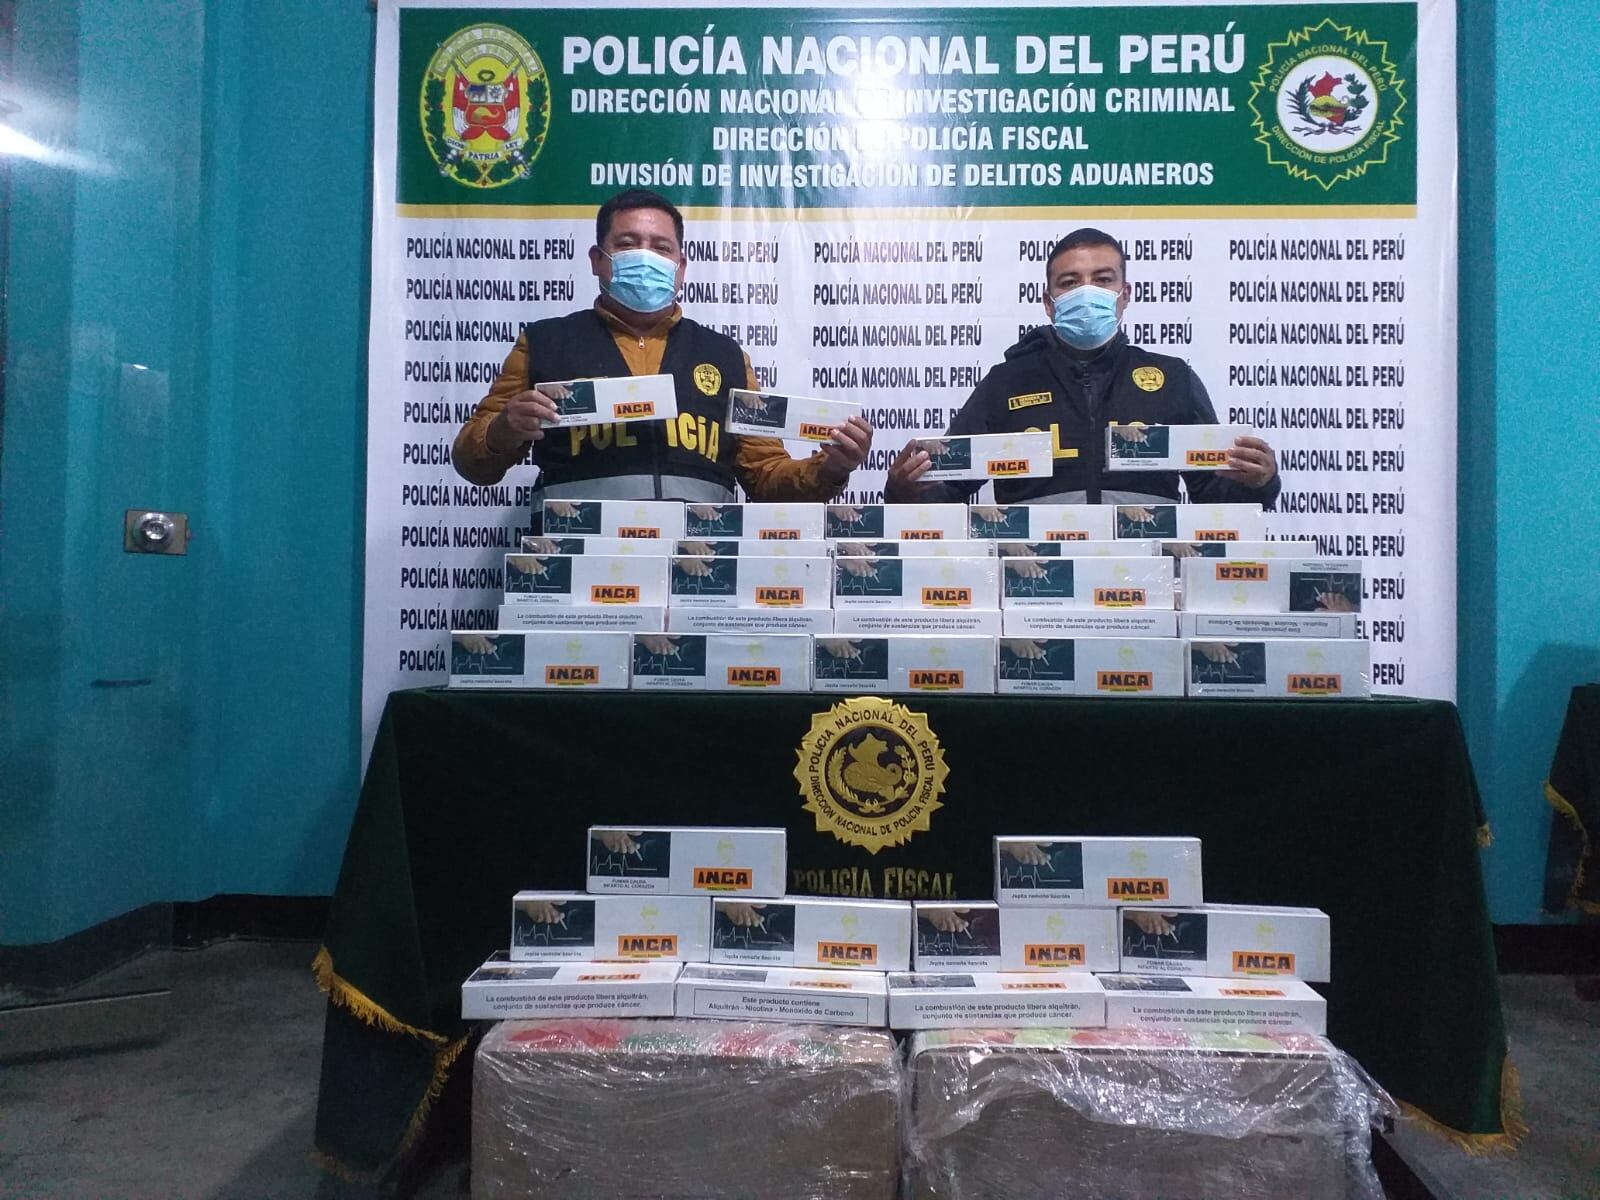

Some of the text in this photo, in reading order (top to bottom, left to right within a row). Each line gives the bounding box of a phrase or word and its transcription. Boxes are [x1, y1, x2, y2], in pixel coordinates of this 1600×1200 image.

[563, 24, 746, 75] POLICÍA
[763, 33, 998, 75] NACIONAL
[1016, 35, 1103, 74] DEL
[1120, 21, 1245, 74] PERÚ
[571, 85, 709, 113] DIRECCIÓN
[721, 88, 848, 114] NACIONAL
[899, 83, 1096, 114] INVESTIGACIÓN
[1106, 87, 1236, 112] CRIMINAL
[713, 122, 849, 151] DIRECCIÓN
[900, 121, 994, 151] POLICÍA
[1003, 126, 1089, 150] FISCAL
[468, 151, 500, 161] PATRIA
[591, 159, 692, 186] DIVISIÓN
[702, 164, 730, 186] DE
[926, 164, 956, 187] DE
[965, 163, 1062, 187] DELITOS
[1069, 162, 1214, 186] ADUANEROS
[407, 232, 574, 260] POLICÍA NACIONAL DEL PERÚ
[723, 236, 778, 263] DEL PERÚ
[1135, 234, 1192, 260] DEL PERÚ
[1230, 234, 1404, 260] POLICÍA NACIONAL DEL PERÚ
[407, 273, 574, 301] POLICÍA NACIONAL DEL PERÚ
[814, 276, 982, 305] POLICÍA NACIONAL DEL PERÚ
[1230, 275, 1404, 302] POLICÍA NACIONAL DEL PERÚ
[406, 315, 515, 342] POLICÍA NACIONAL
[813, 319, 981, 347] POLICÍA NACIONAL DEL PERÚ
[1134, 317, 1192, 344] DEL PERÚ
[1230, 317, 1404, 344] POLICÍA NACIONAL DEL PERÚ
[405, 355, 451, 382] POLICÍA
[813, 361, 946, 388] POLICÍA NACIONAL DEL
[617, 403, 652, 415] INCA
[1281, 402, 1404, 429] NACIONAL DEL PERÚ
[990, 462, 1028, 473] INCA
[1190, 452, 1227, 462] INCA
[403, 479, 512, 507] POLICÍA NACIONAL
[1281, 487, 1404, 514] NACIONAL DEL PERÚ
[402, 520, 512, 548] POLICÍA NACIONAL
[1219, 567, 1264, 578] INCA
[594, 588, 636, 600] INCA
[759, 589, 800, 600] INCA
[926, 590, 968, 601] INCA
[1100, 590, 1144, 602] INCA
[401, 603, 448, 630] POLICÍA
[400, 644, 446, 672] POLICÍA
[1373, 658, 1404, 685] PERÚ
[550, 667, 596, 680] INCA
[731, 669, 778, 682] INCA
[913, 672, 960, 685] INCA
[1101, 673, 1149, 687] INCA
[1292, 677, 1338, 690] INCA
[809, 709, 935, 773] POLICIA NACIONAL DEL PERU
[808, 775, 934, 836] DIRECCION NACIONAL DE POLICIA FISCAL
[697, 871, 748, 885] INCA
[1112, 880, 1166, 895] INCA
[623, 938, 673, 952] INCA
[822, 945, 873, 960] INCA
[1029, 947, 1082, 961] INCA
[1237, 954, 1291, 970] INCA
